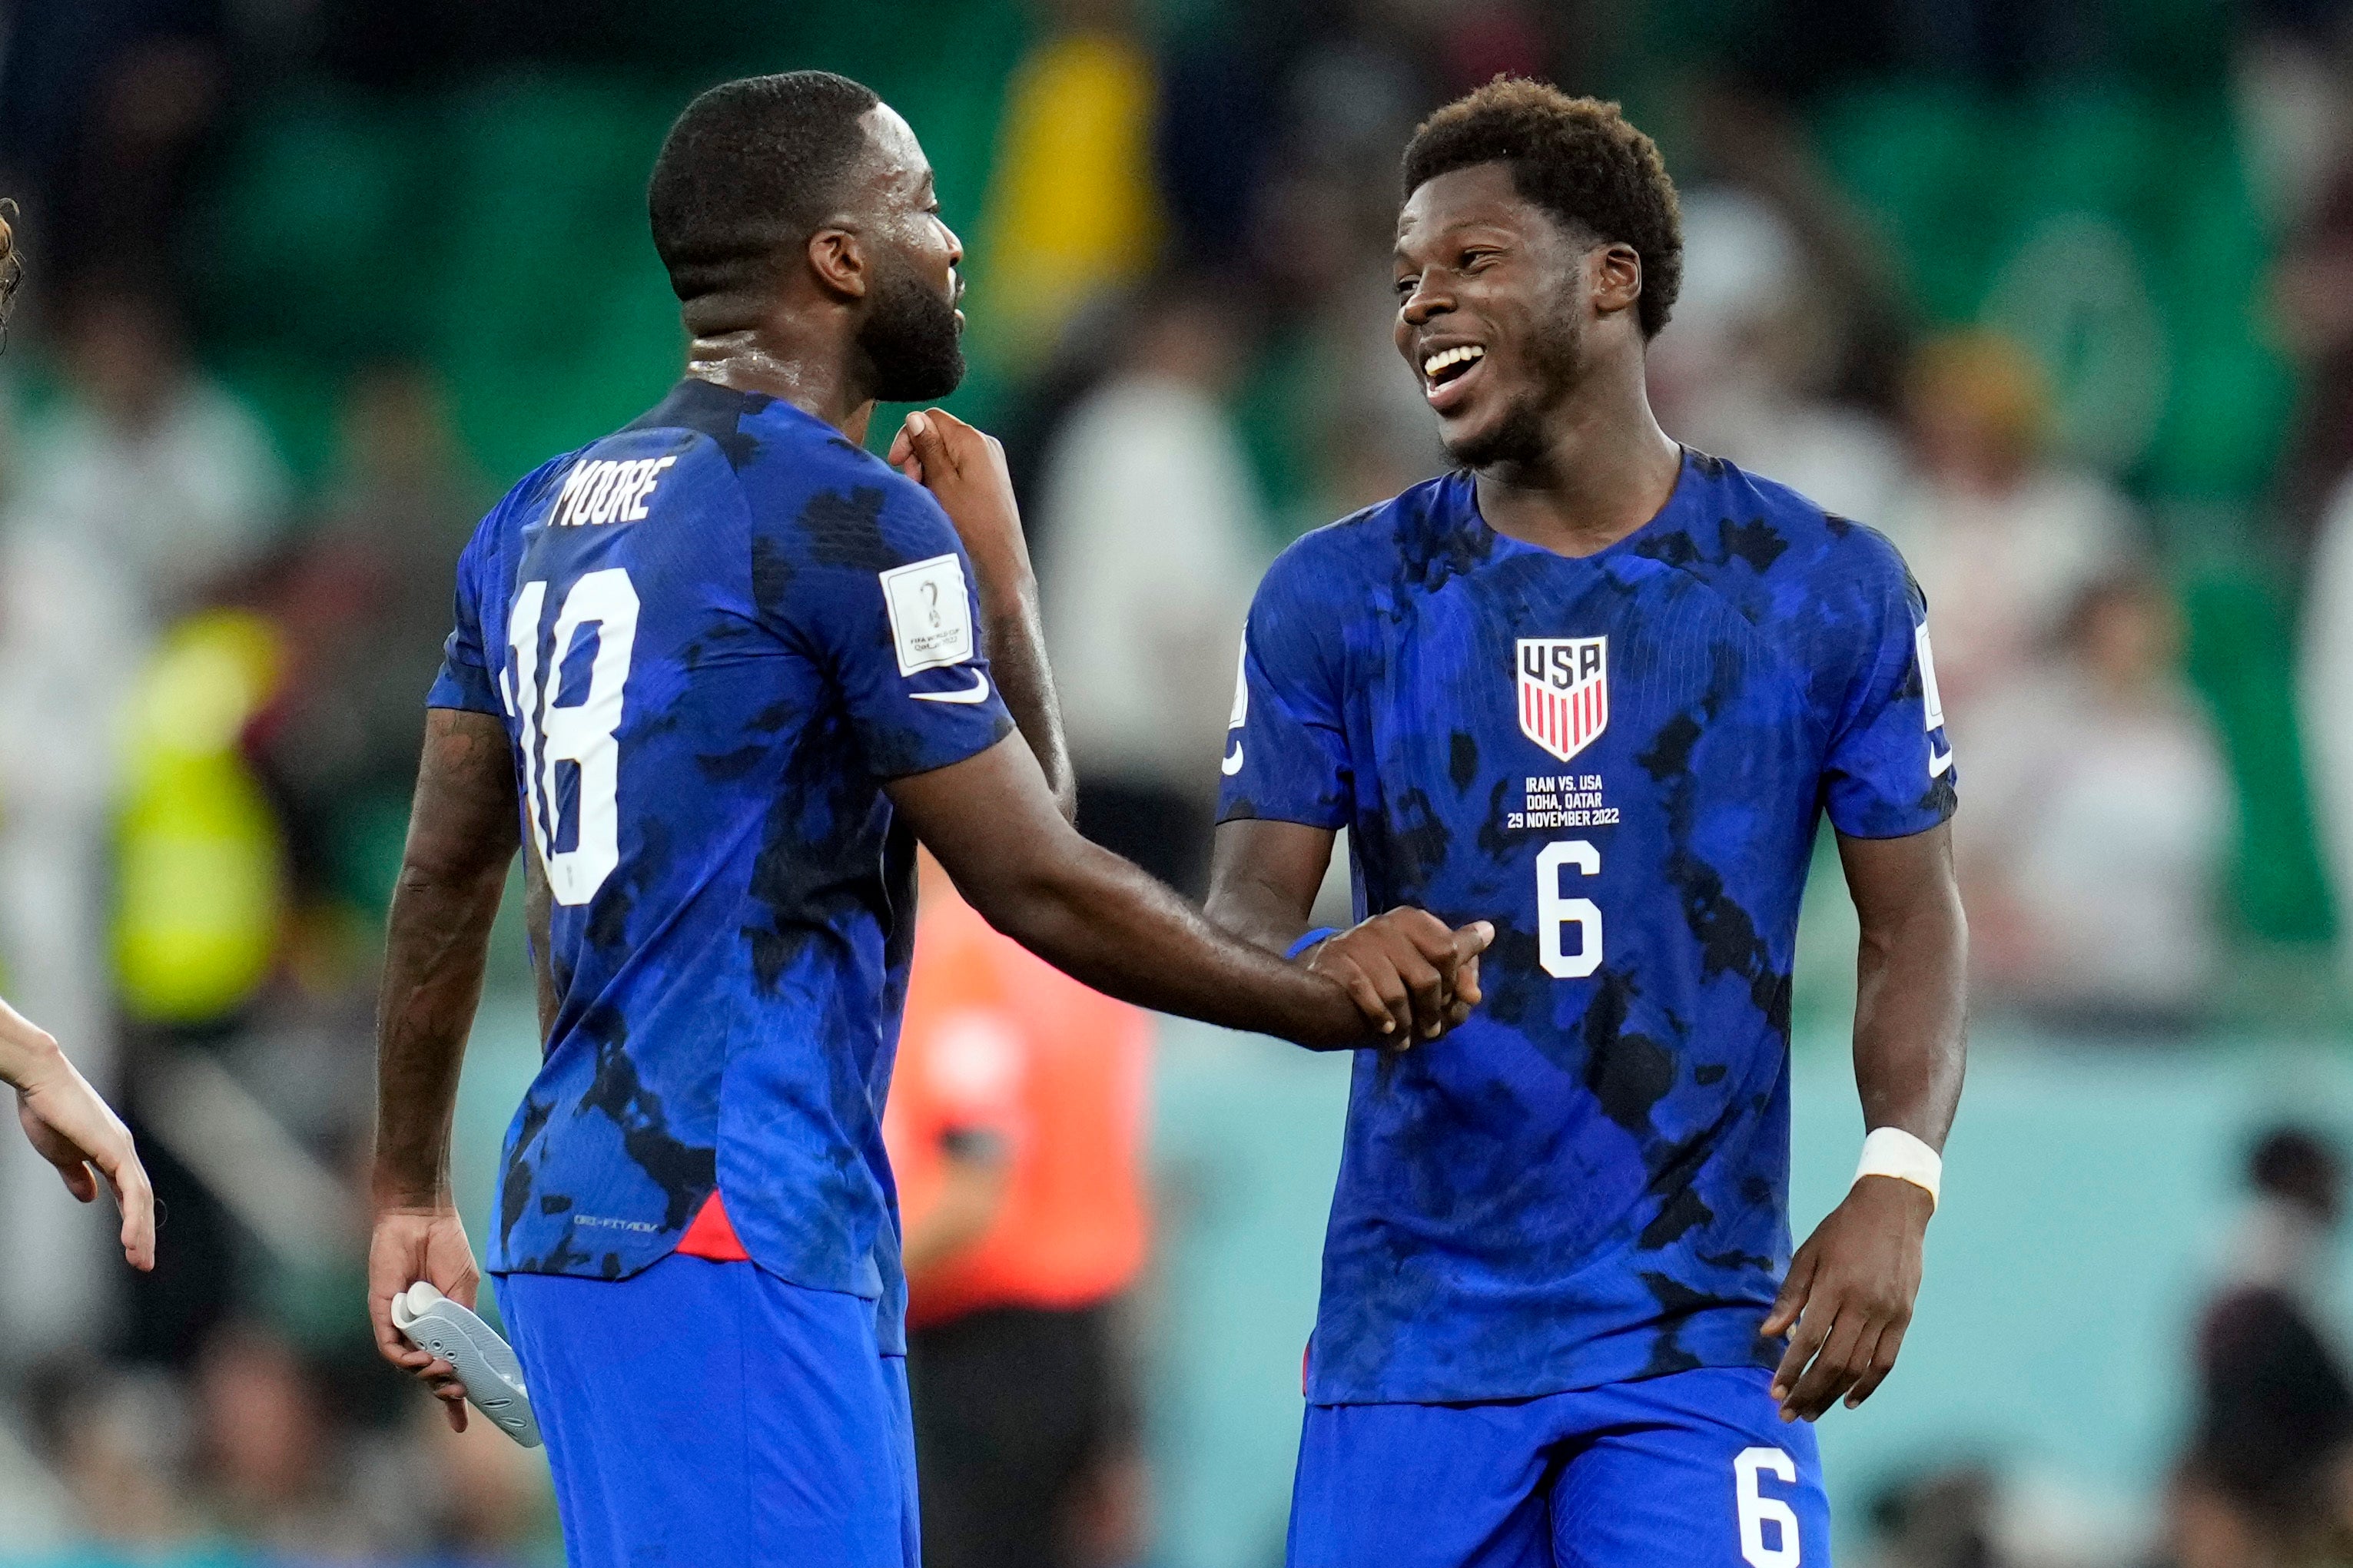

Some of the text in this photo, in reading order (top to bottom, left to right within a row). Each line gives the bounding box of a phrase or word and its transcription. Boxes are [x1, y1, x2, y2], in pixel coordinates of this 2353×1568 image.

[548, 456, 677, 526] MOORE
[1524, 644, 1601, 690] USA
[499, 567, 640, 906] 18
[1525, 774, 1603, 793] IRAN VS. USA
[1526, 792, 1602, 811] DOHA, QATAR
[1507, 807, 1620, 828] 29 NOVEMBER 2022
[1536, 840, 1603, 979] 6
[1733, 1447, 1801, 1568] 6
